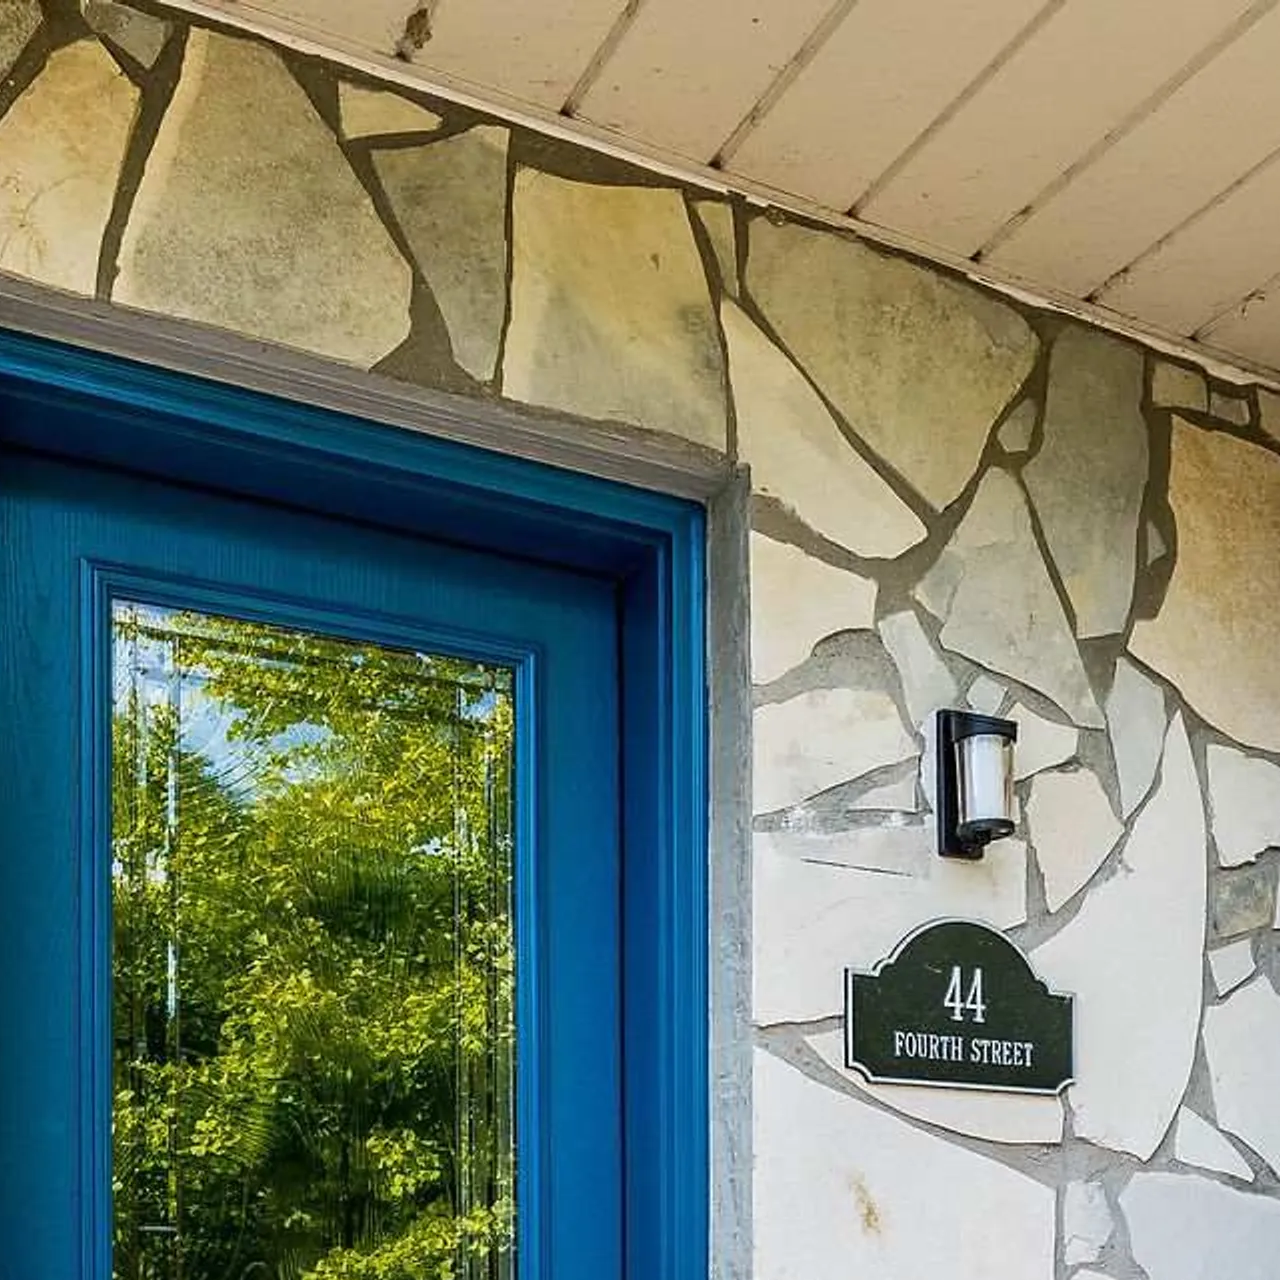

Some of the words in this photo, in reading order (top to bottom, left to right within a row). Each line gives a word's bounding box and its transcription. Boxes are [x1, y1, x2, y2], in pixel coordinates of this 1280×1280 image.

[943, 966, 986, 1023] 44
[894, 1031, 964, 1061] FOURTH
[970, 1038, 1034, 1067] STREET
